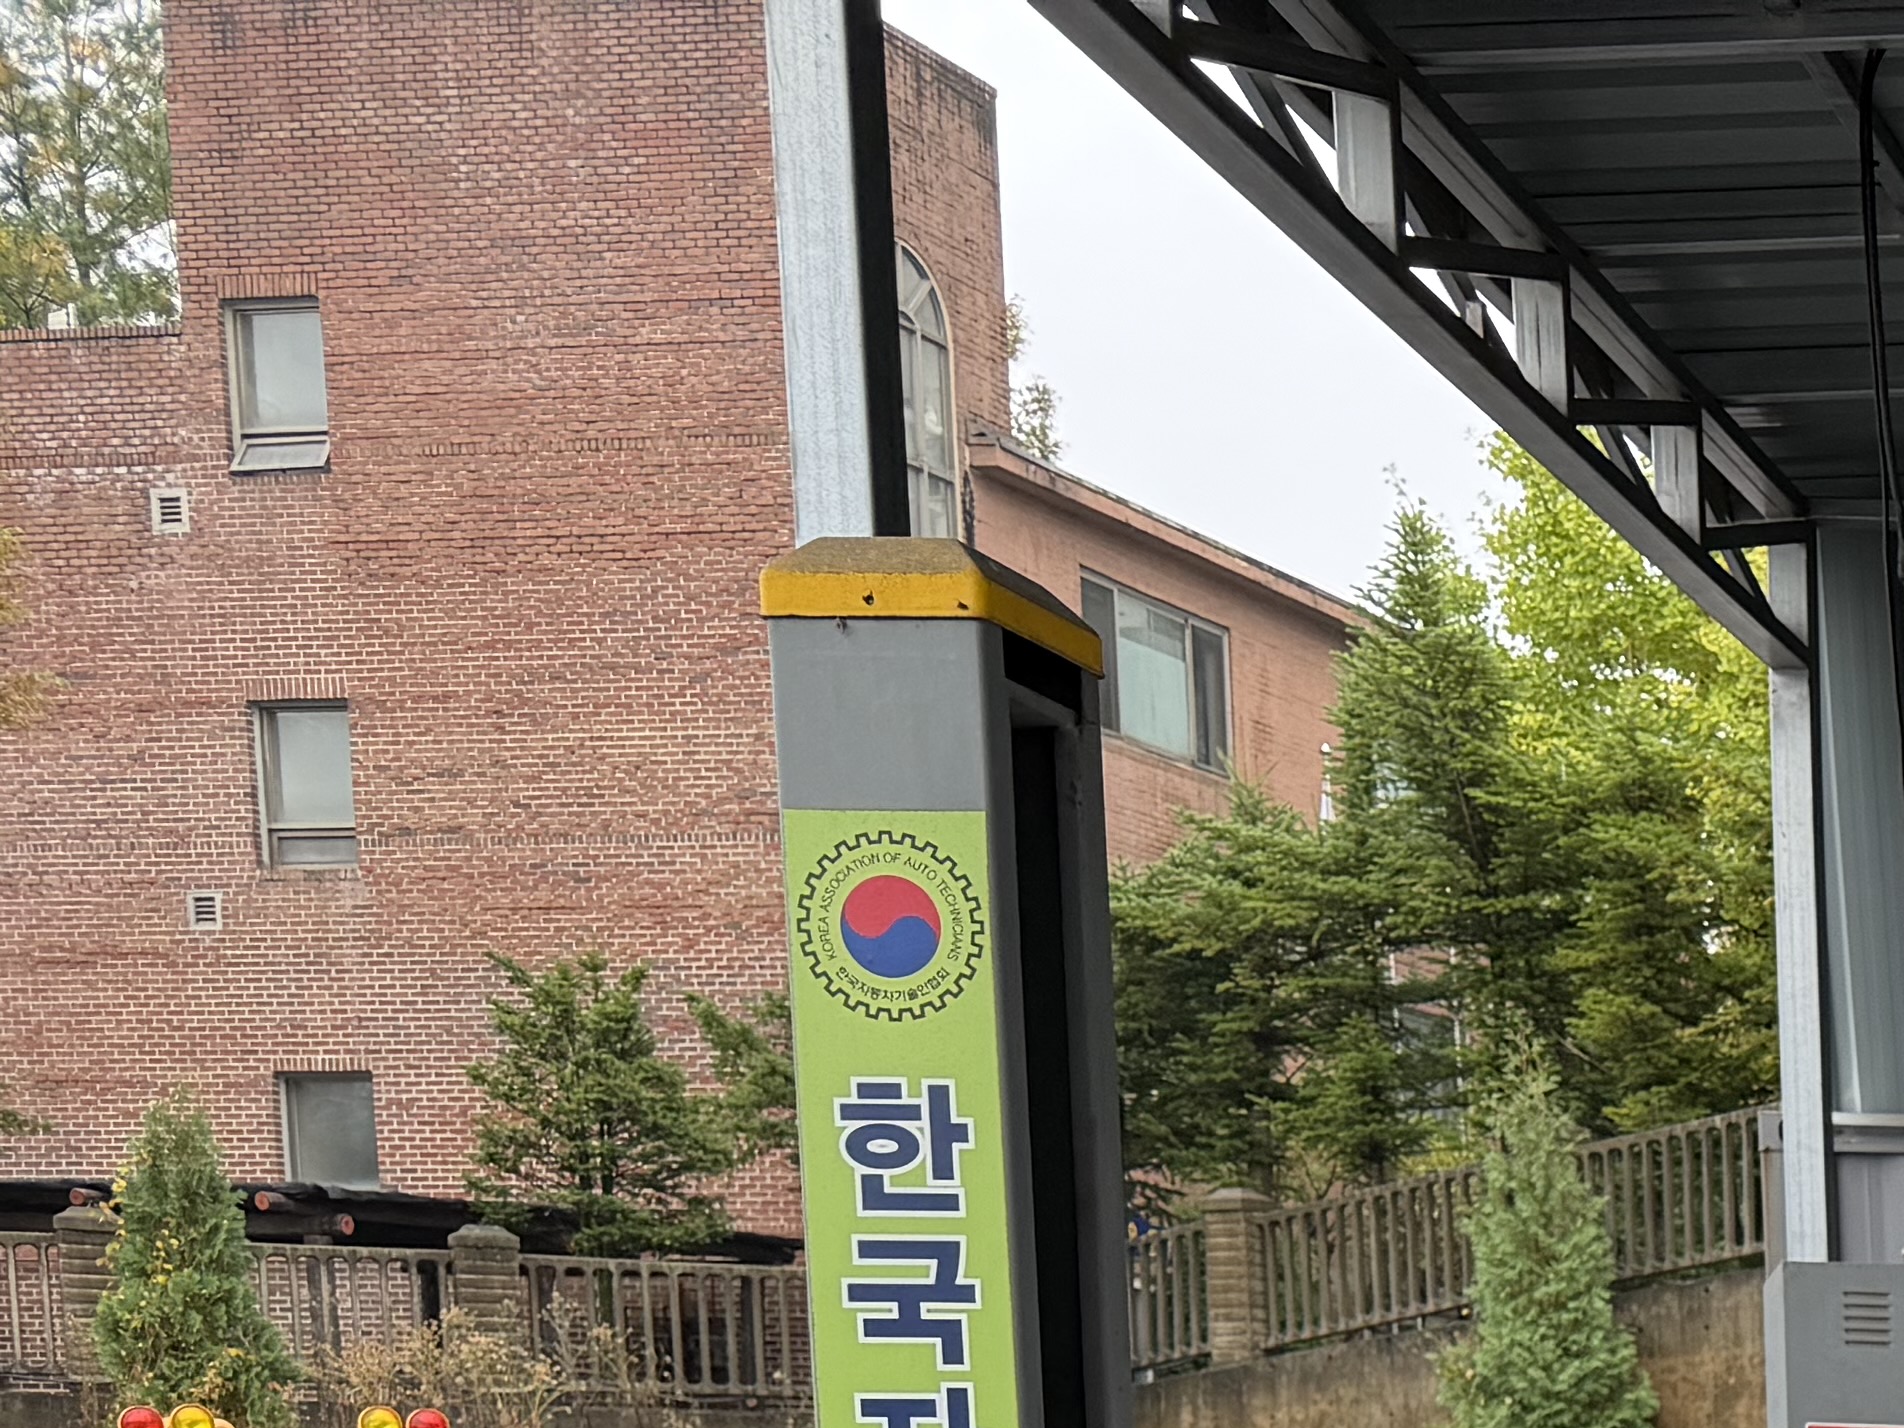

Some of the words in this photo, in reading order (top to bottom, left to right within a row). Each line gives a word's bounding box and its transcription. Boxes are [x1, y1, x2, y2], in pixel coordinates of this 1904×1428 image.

[883, 852, 901, 863] OF
[904, 857, 938, 881] AUTO
[821, 852, 881, 912] ASSOCIATION
[818, 916, 837, 960] KOREA
[936, 878, 964, 962] TECHNICIANS
